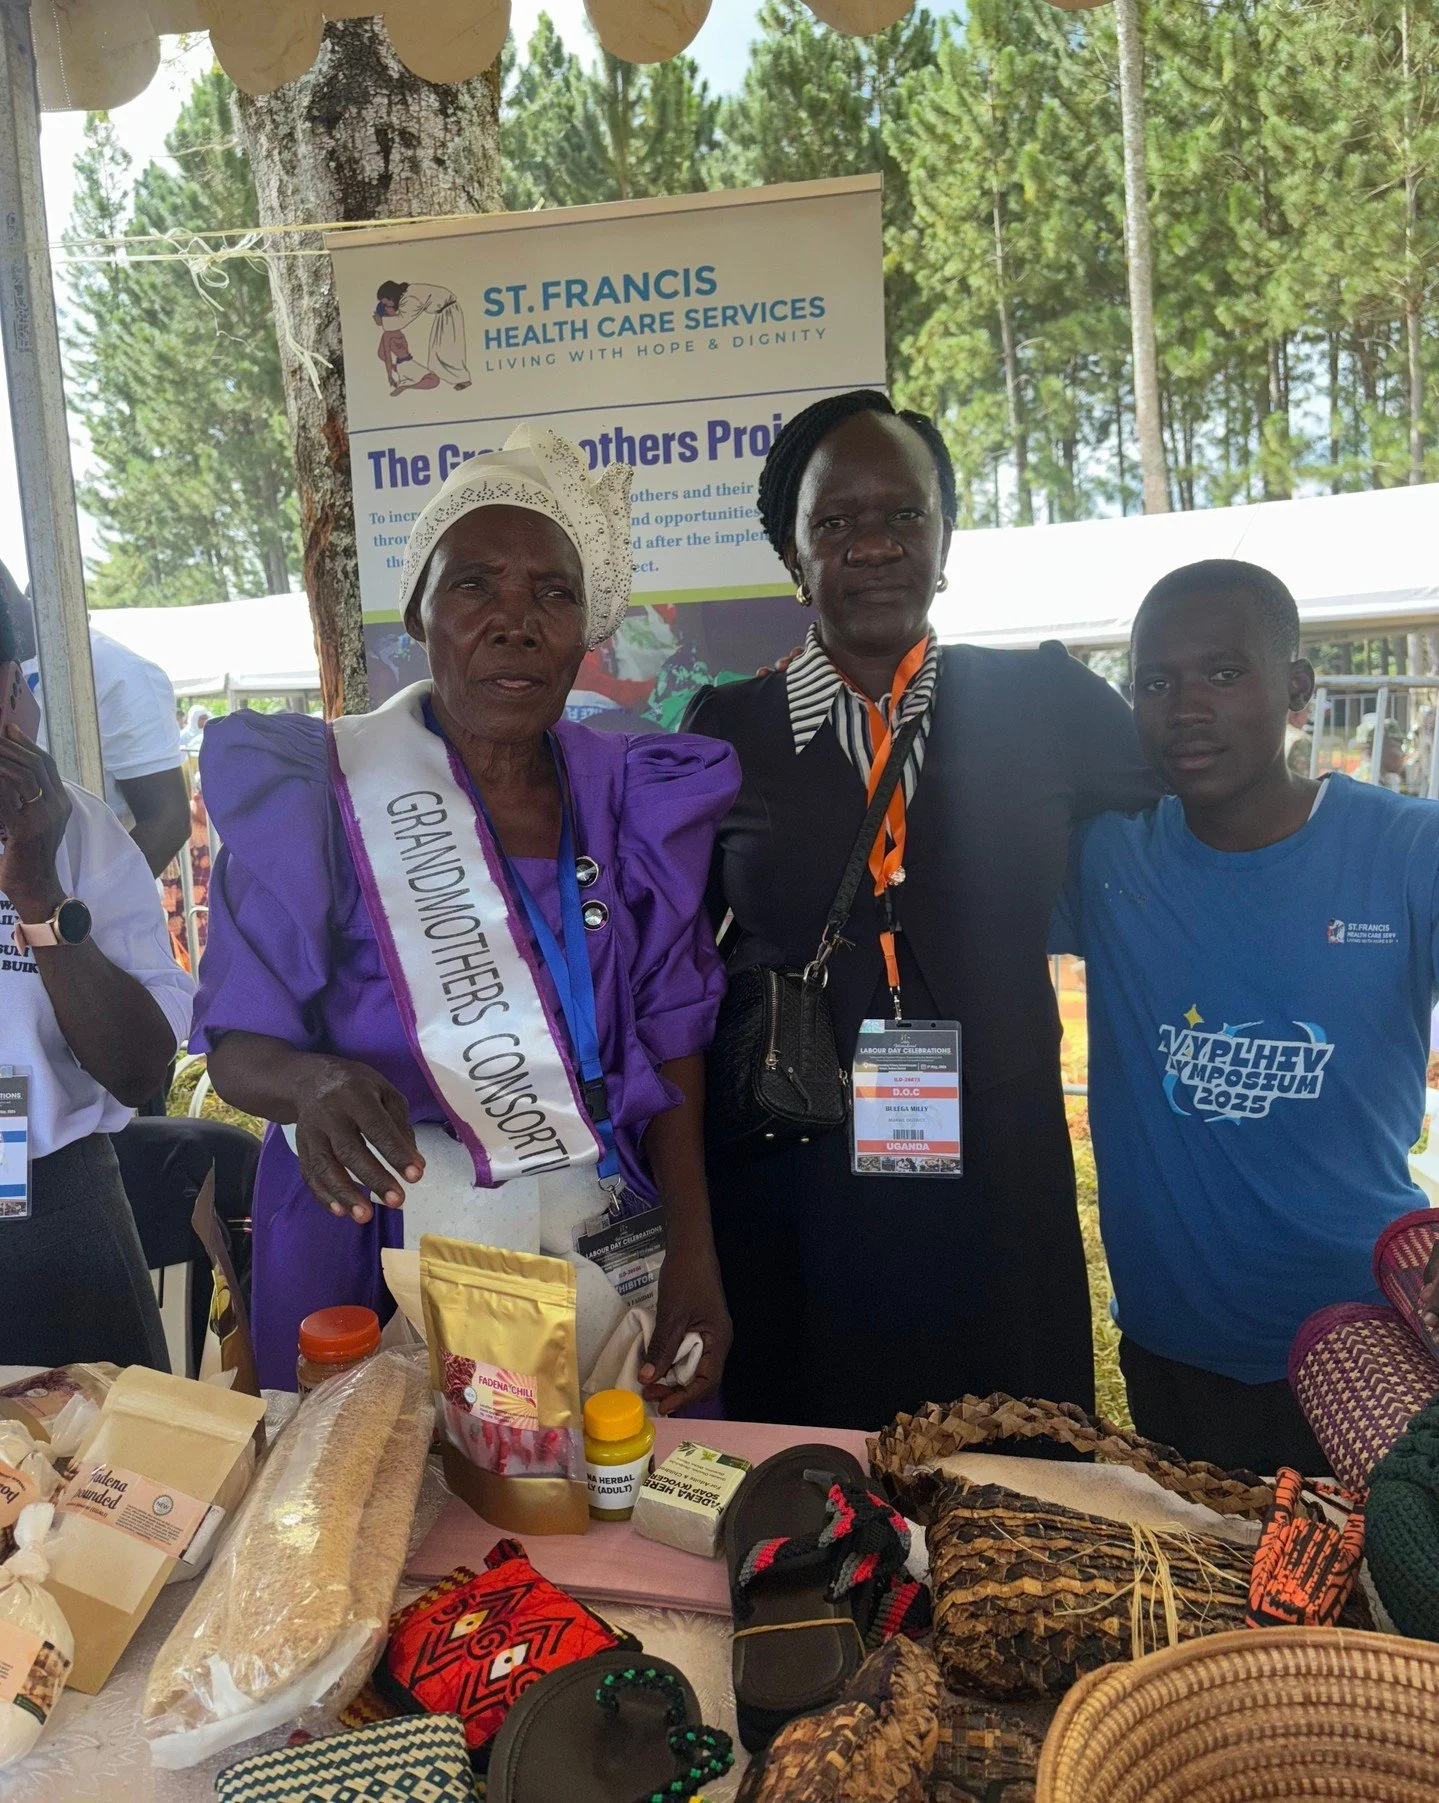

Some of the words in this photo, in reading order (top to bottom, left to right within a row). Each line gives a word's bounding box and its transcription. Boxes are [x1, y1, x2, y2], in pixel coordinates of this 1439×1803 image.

[483, 284, 534, 317] ST.
[541, 265, 718, 311] FRANCIS
[484, 318, 589, 350] HEALTH
[597, 311, 676, 338] CARE
[684, 296, 826, 331] SERVICES
[486, 353, 557, 371] LIVING
[569, 346, 623, 362] WITH
[638, 340, 695, 356] HOPE
[708, 338, 719, 350] &
[733, 327, 827, 348] DIGNITY
[368, 448, 431, 489] The
[630, 488, 679, 502] others
[683, 485, 711, 499] and
[716, 482, 754, 496] their
[369, 512, 385, 524] To
[388, 511, 421, 523] incr
[654, 505, 760, 527] opportunities
[646, 535, 682, 549] after
[687, 532, 711, 546] the
[387, 790, 510, 1027] GRANDMOTHERS
[1358, 923, 1390, 932] FRANCIS
[1169, 1057, 1320, 1095] YMPOSIUM
[892, 1088, 920, 1096] D.O.C
[1196, 1086, 1269, 1114] 2025
[886, 1142, 930, 1151] UGANDA
[585, 1246, 610, 1259] LABOUR
[610, 1241, 622, 1250] DAY
[622, 1225, 663, 1245] CELEBRATIONS
[479, 1375, 509, 1393] FADENA
[511, 1384, 533, 1398] CHILI
[597, 1484, 632, 1494] (ADULT)
[599, 1474, 635, 1485] HERBAL
[677, 1489, 725, 1515] FADENA
[692, 1487, 720, 1500] SOAP
